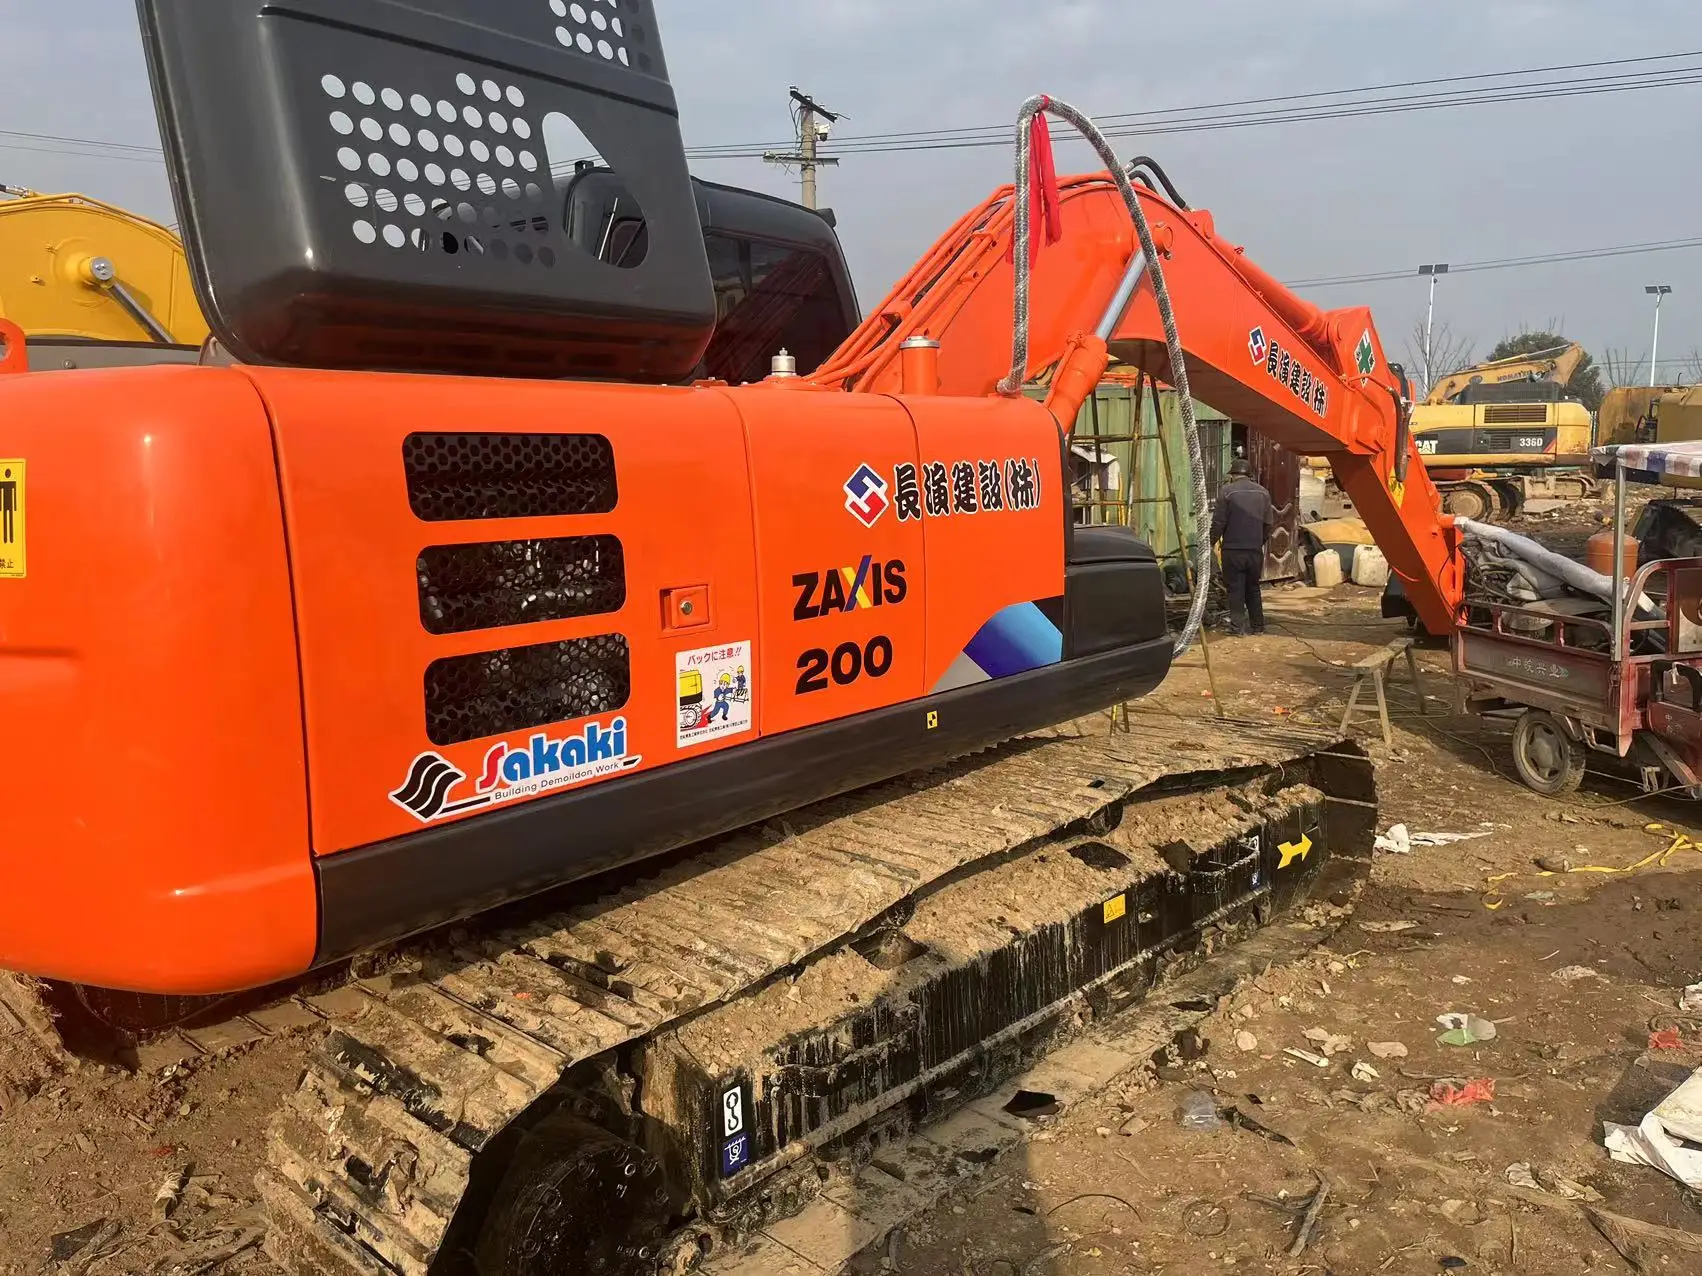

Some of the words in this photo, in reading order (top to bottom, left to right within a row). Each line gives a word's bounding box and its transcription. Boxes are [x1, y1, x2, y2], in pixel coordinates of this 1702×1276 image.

[1415, 440, 1438, 454] CAT
[1519, 437, 1543, 447] 336D
[792, 555, 907, 621] ZAXIS
[795, 635, 893, 695] 200
[479, 719, 625, 789] Sakaki
[494, 782, 538, 800] Building
[595, 762, 620, 774] Work
